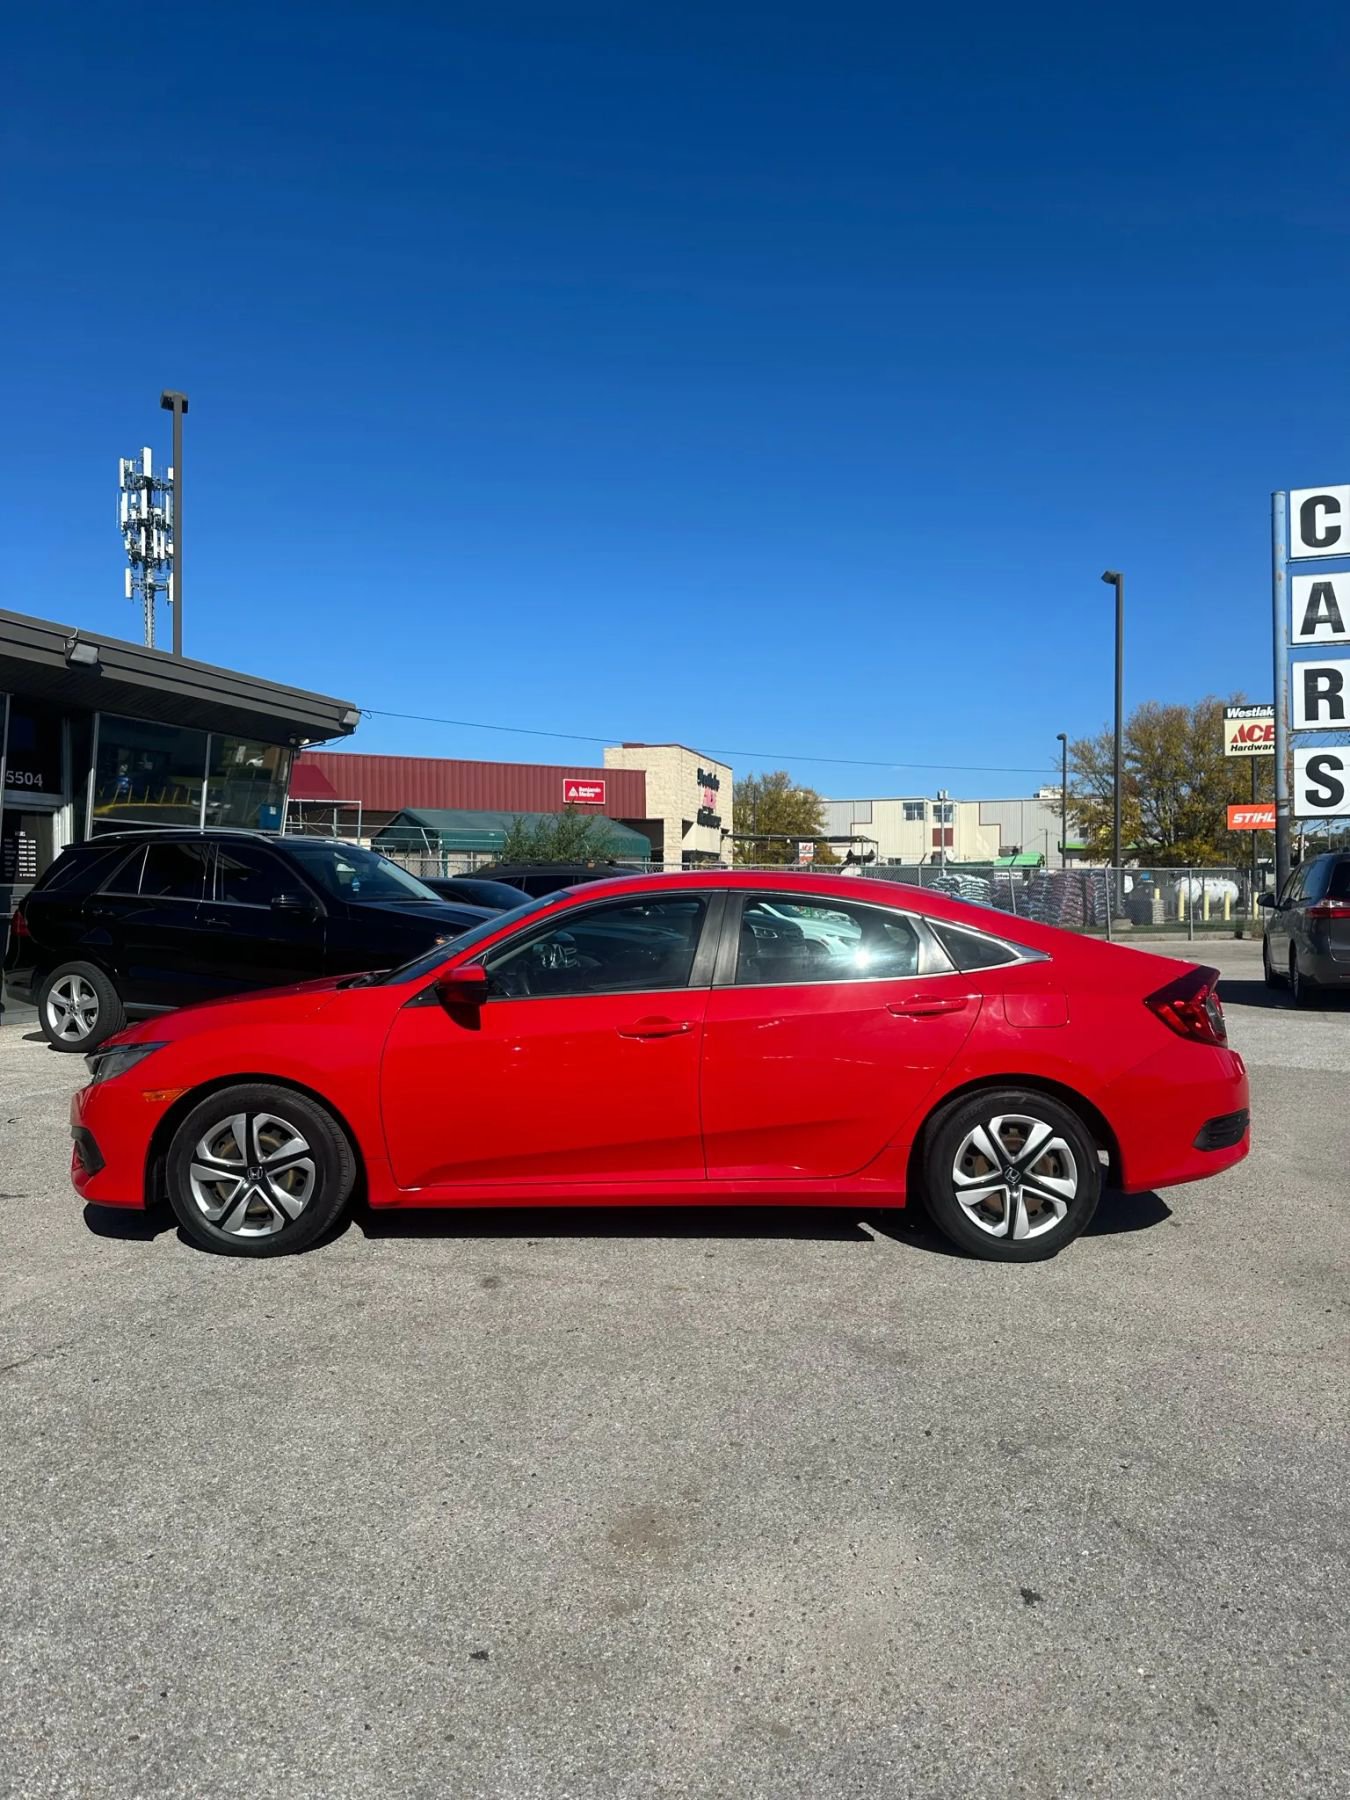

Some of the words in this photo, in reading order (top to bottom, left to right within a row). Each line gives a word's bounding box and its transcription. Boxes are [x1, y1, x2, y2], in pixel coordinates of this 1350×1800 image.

[1300, 494, 1346, 808] CARS
[1227, 706, 1275, 718] Westlak
[1230, 742, 1276, 752] Hardwar
[5, 770, 43, 787] 5504
[1232, 812, 1276, 824] STIHL
